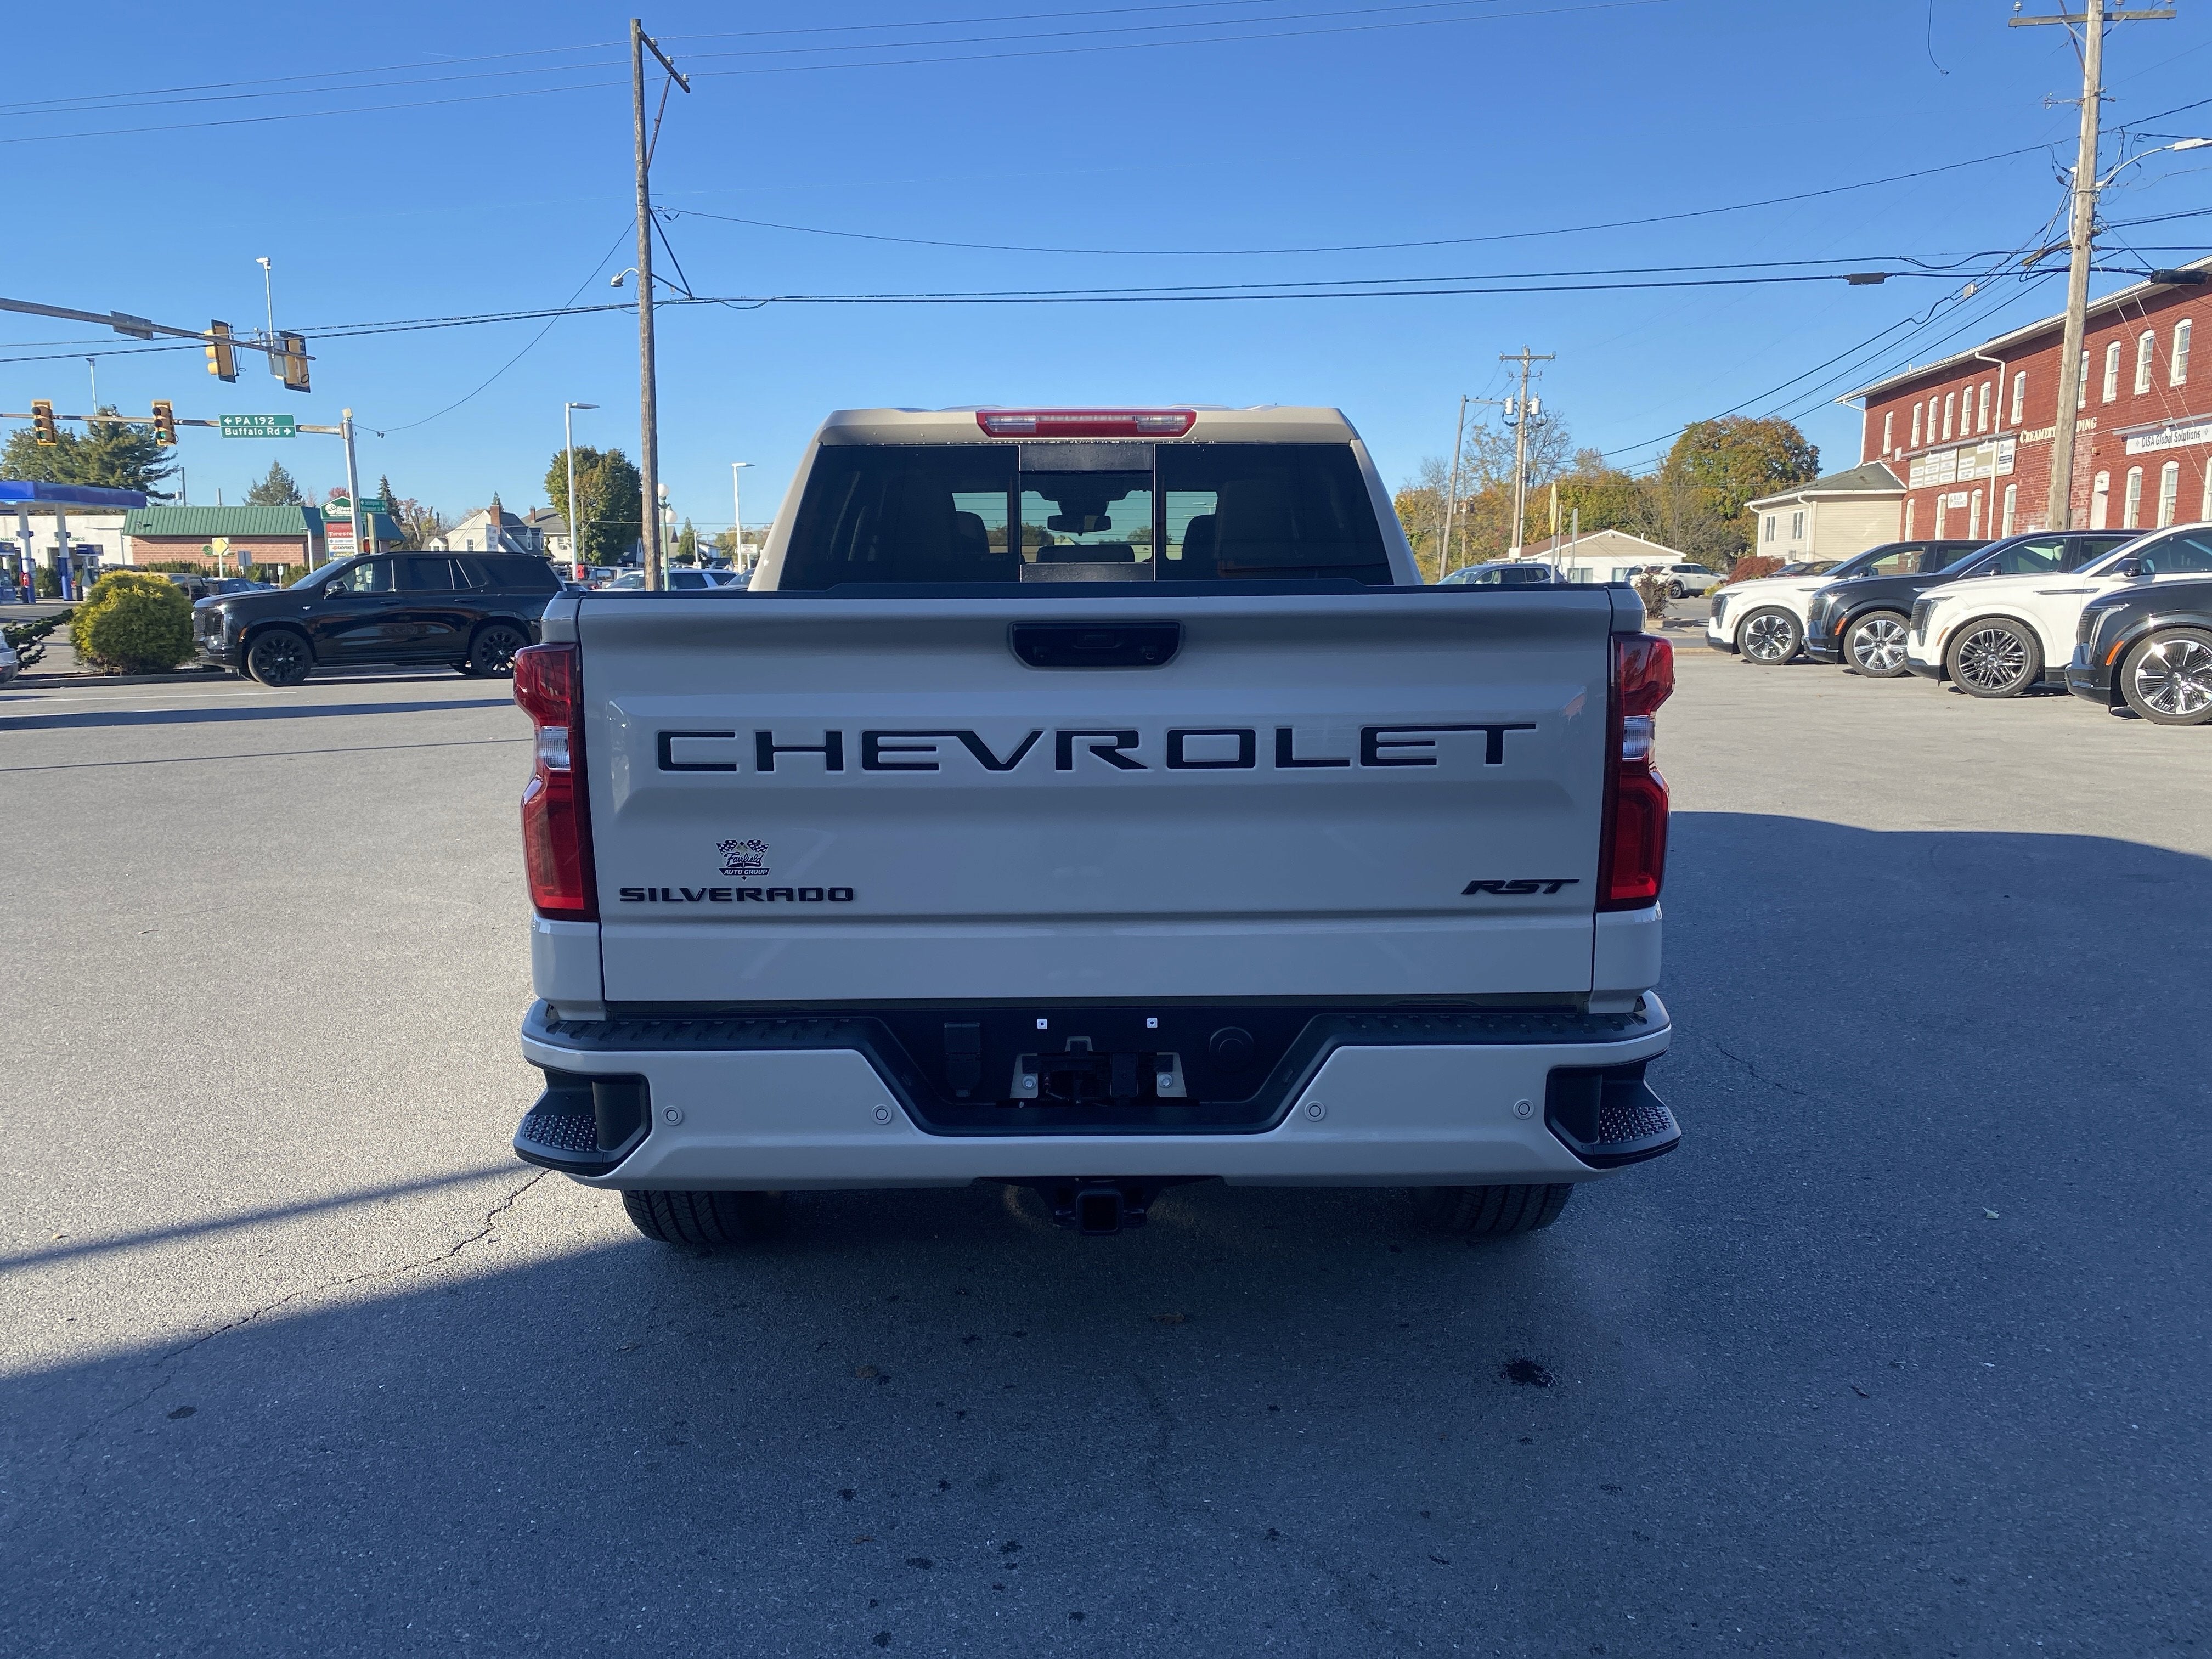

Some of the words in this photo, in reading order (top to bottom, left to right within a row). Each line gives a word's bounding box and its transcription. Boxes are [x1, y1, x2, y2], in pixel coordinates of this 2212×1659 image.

[235, 416, 251, 425] PA
[254, 416, 275, 425] 192
[2075, 416, 2097, 432] DING
[224, 427, 263, 436] Buffalo
[267, 427, 280, 436] Rd
[2141, 436, 2154, 448] DISA
[2155, 431, 2173, 445] Global
[2174, 429, 2201, 443] Solutions
[658, 723, 1536, 771] CHEVROLET
[724, 851, 764, 868] Fairfield
[619, 887, 854, 902] SILVERADO
[1461, 879, 1580, 895] RST
